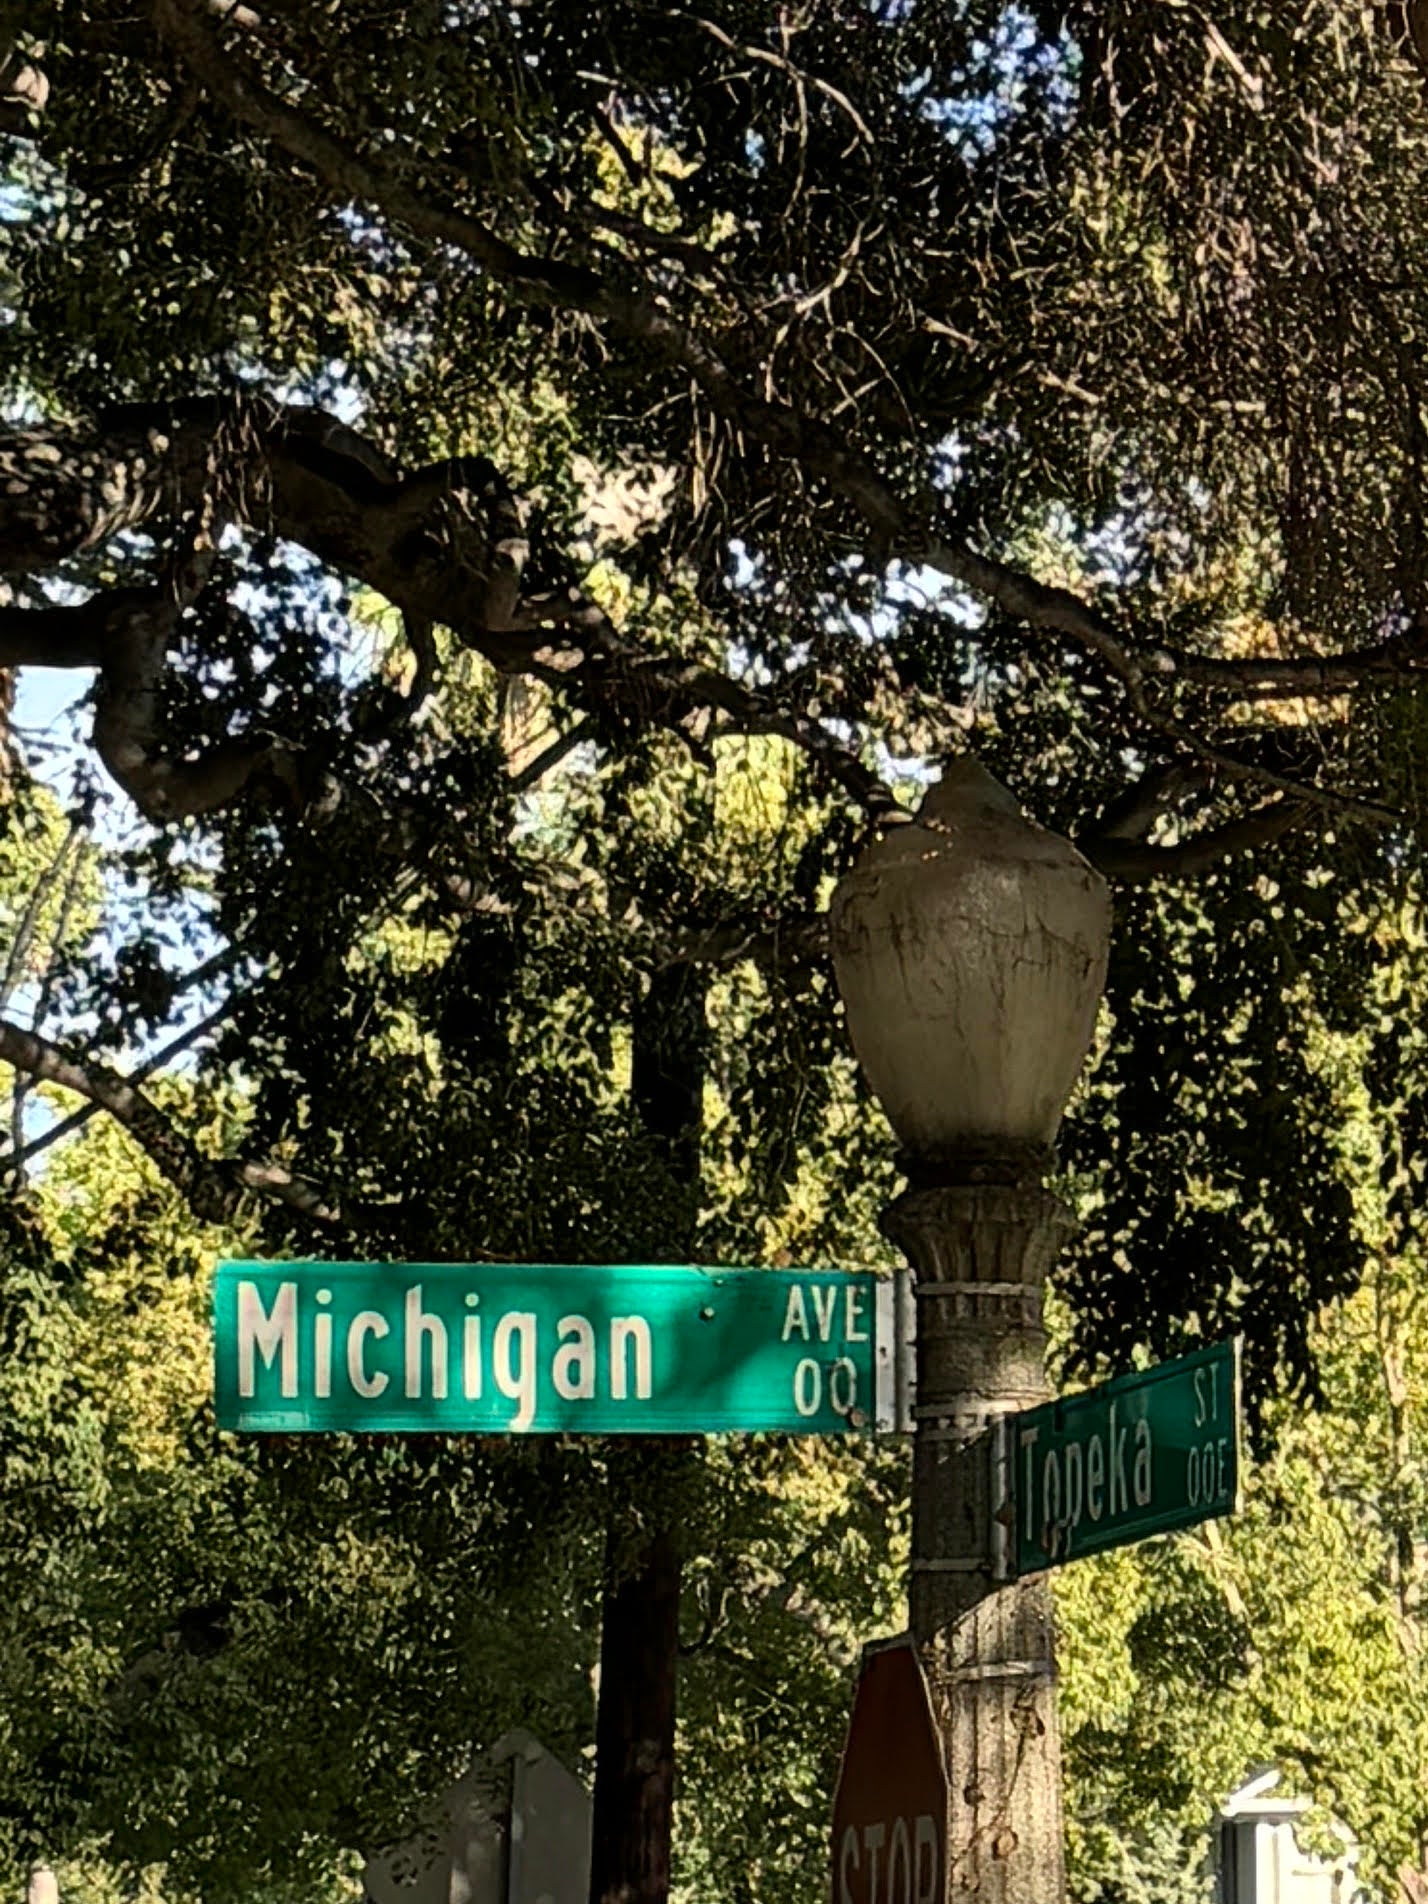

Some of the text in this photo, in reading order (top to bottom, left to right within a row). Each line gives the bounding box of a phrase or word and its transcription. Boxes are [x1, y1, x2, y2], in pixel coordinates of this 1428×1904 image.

[238, 1281, 869, 1433] Michigan AVE
[793, 1355, 858, 1416] 00
[1020, 1362, 1219, 1558] Topeka ST
[1187, 1437, 1228, 1508] 00E
